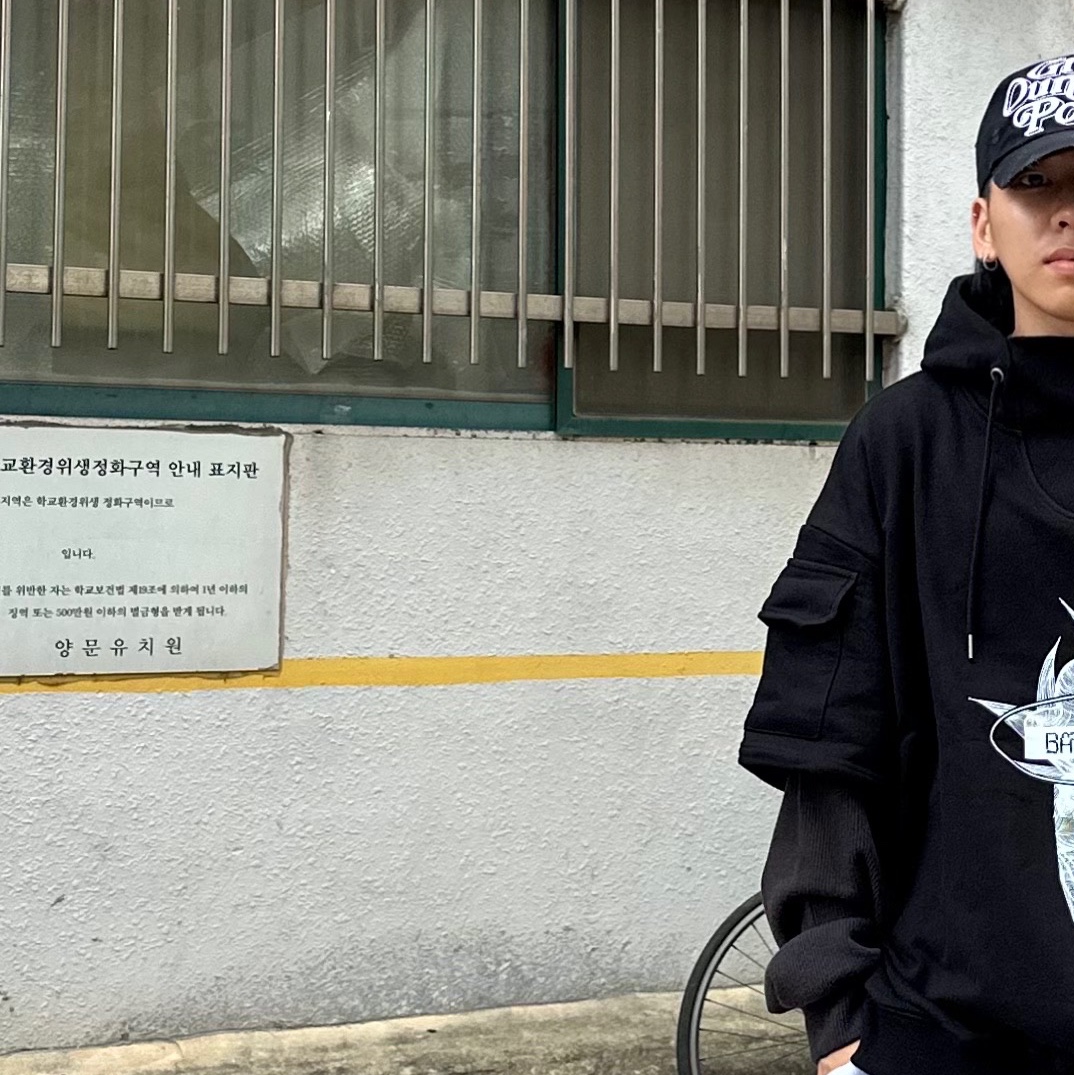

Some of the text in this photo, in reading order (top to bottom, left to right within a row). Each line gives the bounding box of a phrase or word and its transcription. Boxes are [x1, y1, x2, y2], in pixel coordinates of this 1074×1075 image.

[0, 455, 261, 480] 교환경위생정화구역 안내 표지판
[35, 495, 100, 509] 학교환경위생
[60, 547, 99, 560] 입니다.
[0, 584, 13, 597] 를
[15, 584, 48, 597] 위반한
[48, 584, 72, 597] 자는
[73, 583, 125, 597] 학교보건법
[169, 583, 200, 596] 의하여
[202, 583, 217, 596] 1년
[218, 583, 249, 596] 이하의
[7, 606, 29, 620] 징역
[31, 607, 55, 619] 또는
[55, 605, 94, 619] 500만원
[95, 605, 127, 619] 이하의
[129, 605, 171, 619] 벌금형을
[172, 605, 193, 618] 받게
